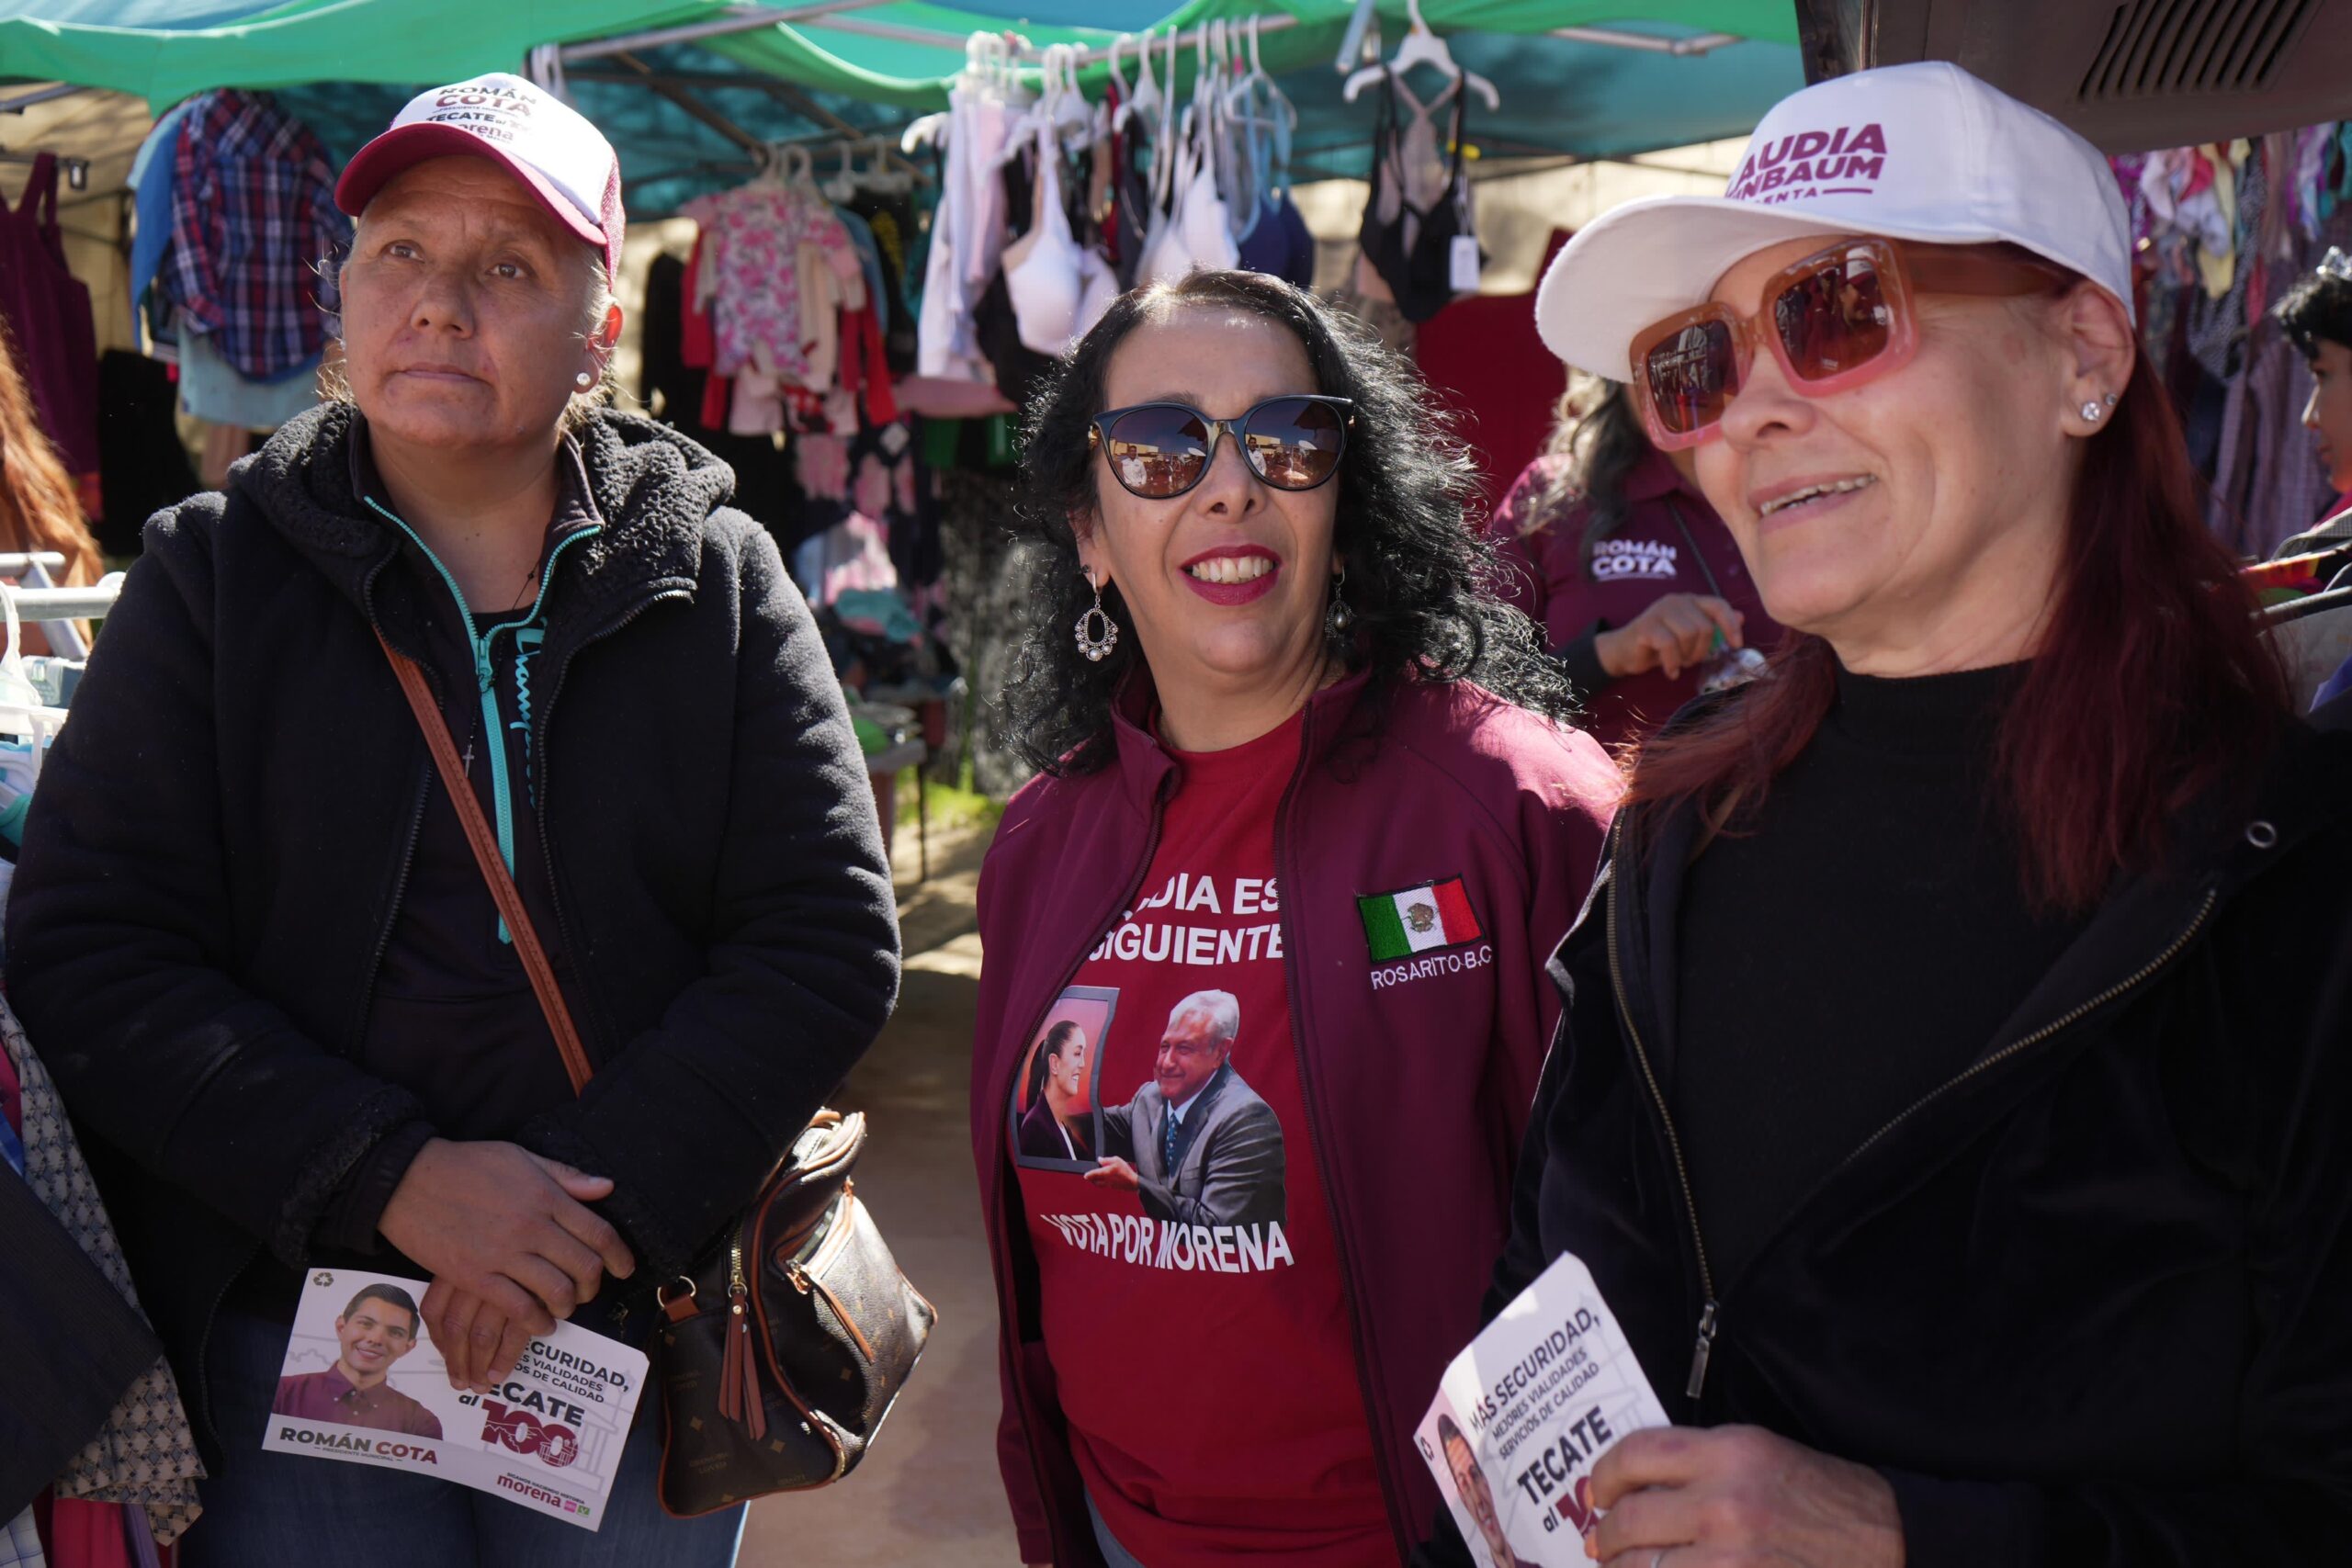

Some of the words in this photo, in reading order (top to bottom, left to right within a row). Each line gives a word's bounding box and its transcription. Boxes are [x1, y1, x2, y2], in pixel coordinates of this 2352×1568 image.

[426, 111, 496, 122] TECATE
[435, 95, 531, 116] COTA
[1756, 186, 1817, 204] ENTA
[1592, 554, 1677, 576] COTA
[1233, 877, 1279, 915] ES
[1371, 955, 1460, 990] ROSARITO
[1040, 1213, 1108, 1258] VOTA
[1107, 1213, 1154, 1267] POR
[1154, 1220, 1295, 1273] MORENA
[526, 1339, 629, 1393] GURIDAD,
[1495, 1306, 1600, 1407] SEGURIDAD,
[533, 1357, 604, 1393] VIALIDADES
[533, 1371, 548, 1382] DE
[551, 1377, 605, 1404] CALIDAD
[1492, 1400, 1529, 1441] MEJORES
[1528, 1346, 1588, 1403] VIALIDADES
[1498, 1416, 1541, 1461] SERVICIOS
[1539, 1402, 1554, 1422] DE
[1553, 1361, 1600, 1409] CALIDAD
[279, 1427, 371, 1451] ROMÁN
[376, 1441, 437, 1464] COTA
[458, 1393, 480, 1406] al
[481, 1398, 579, 1467] 100
[1517, 1404, 1612, 1506] TECATE
[497, 1474, 562, 1508] morena
[1543, 1506, 1559, 1533] al
